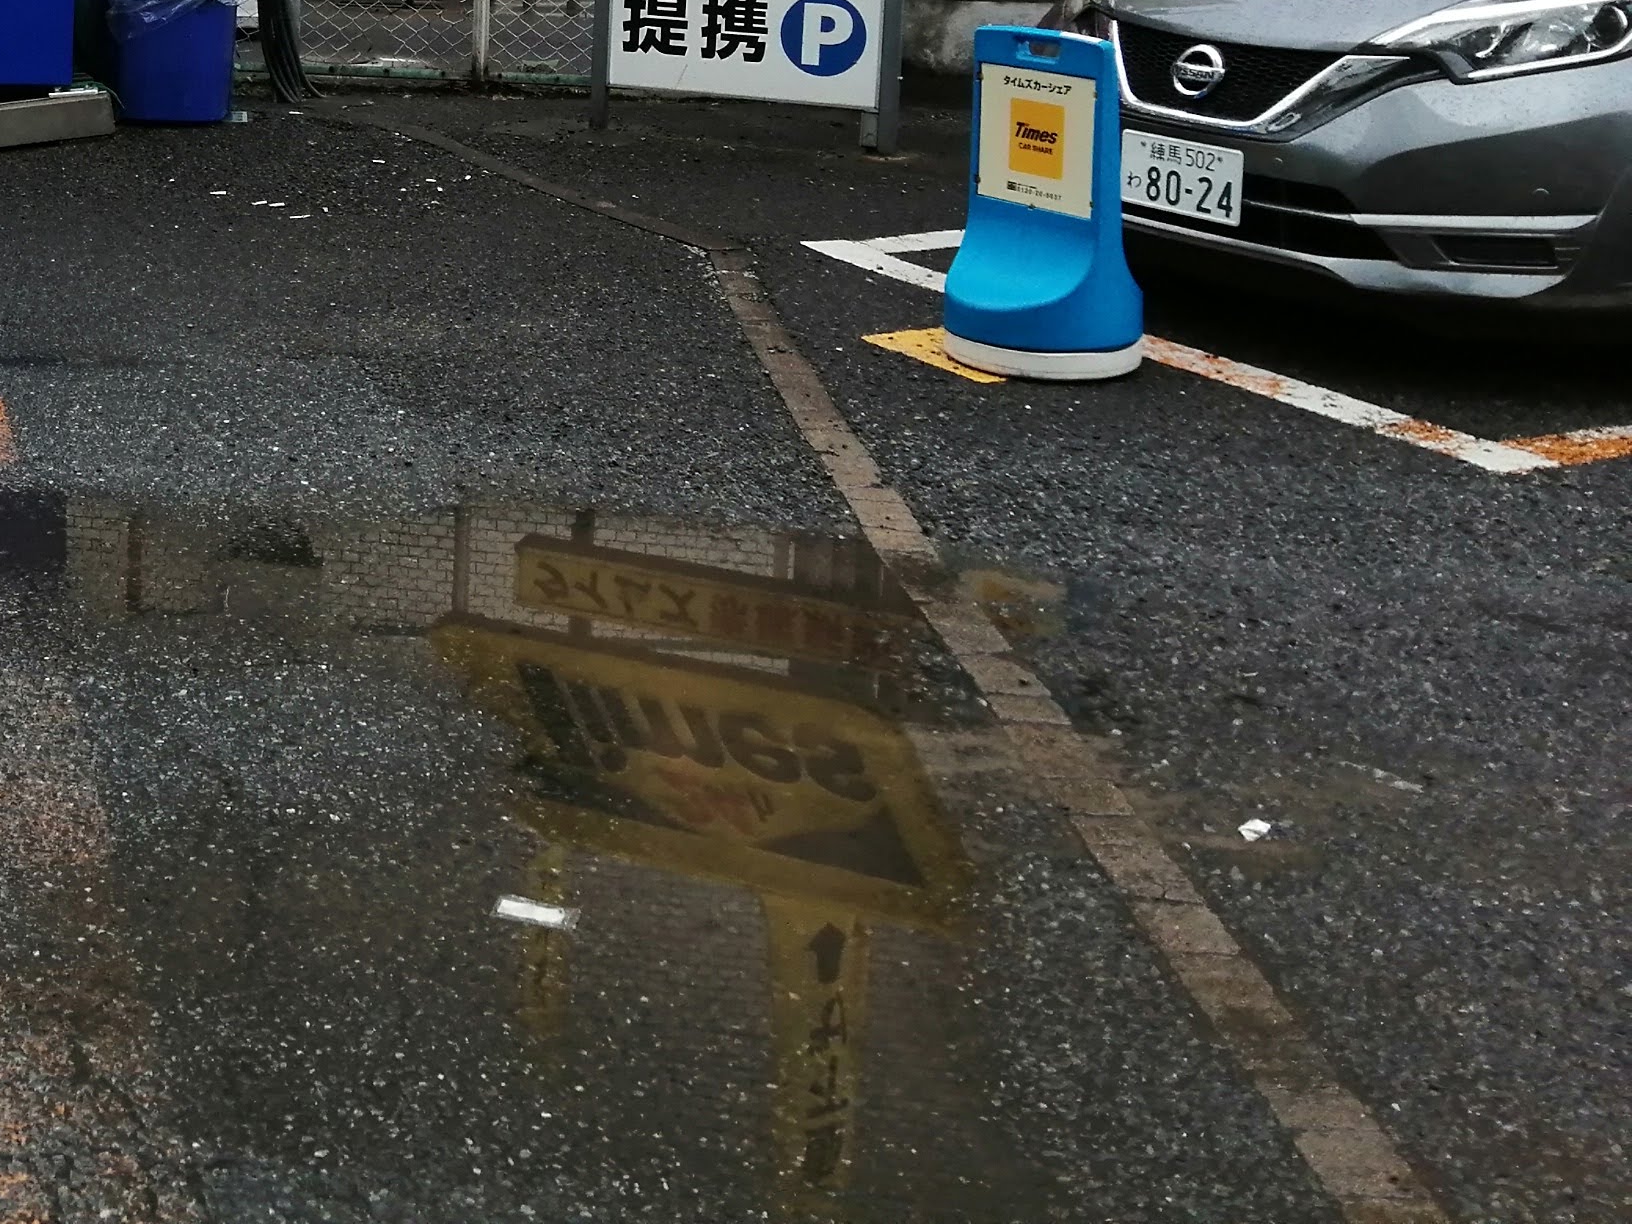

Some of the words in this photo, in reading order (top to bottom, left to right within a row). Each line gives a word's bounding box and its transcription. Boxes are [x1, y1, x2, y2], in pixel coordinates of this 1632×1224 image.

[1003, 75, 1072, 95] タイムズカーシェア
[1014, 121, 1058, 144] Times
[1018, 142, 1032, 151] CAR
[1031, 144, 1054, 156] SHARE
[1150, 142, 1182, 165] 練馬
[1186, 148, 1216, 172] 502
[1127, 170, 1142, 188] わ
[1145, 166, 1233, 218] 80-24
